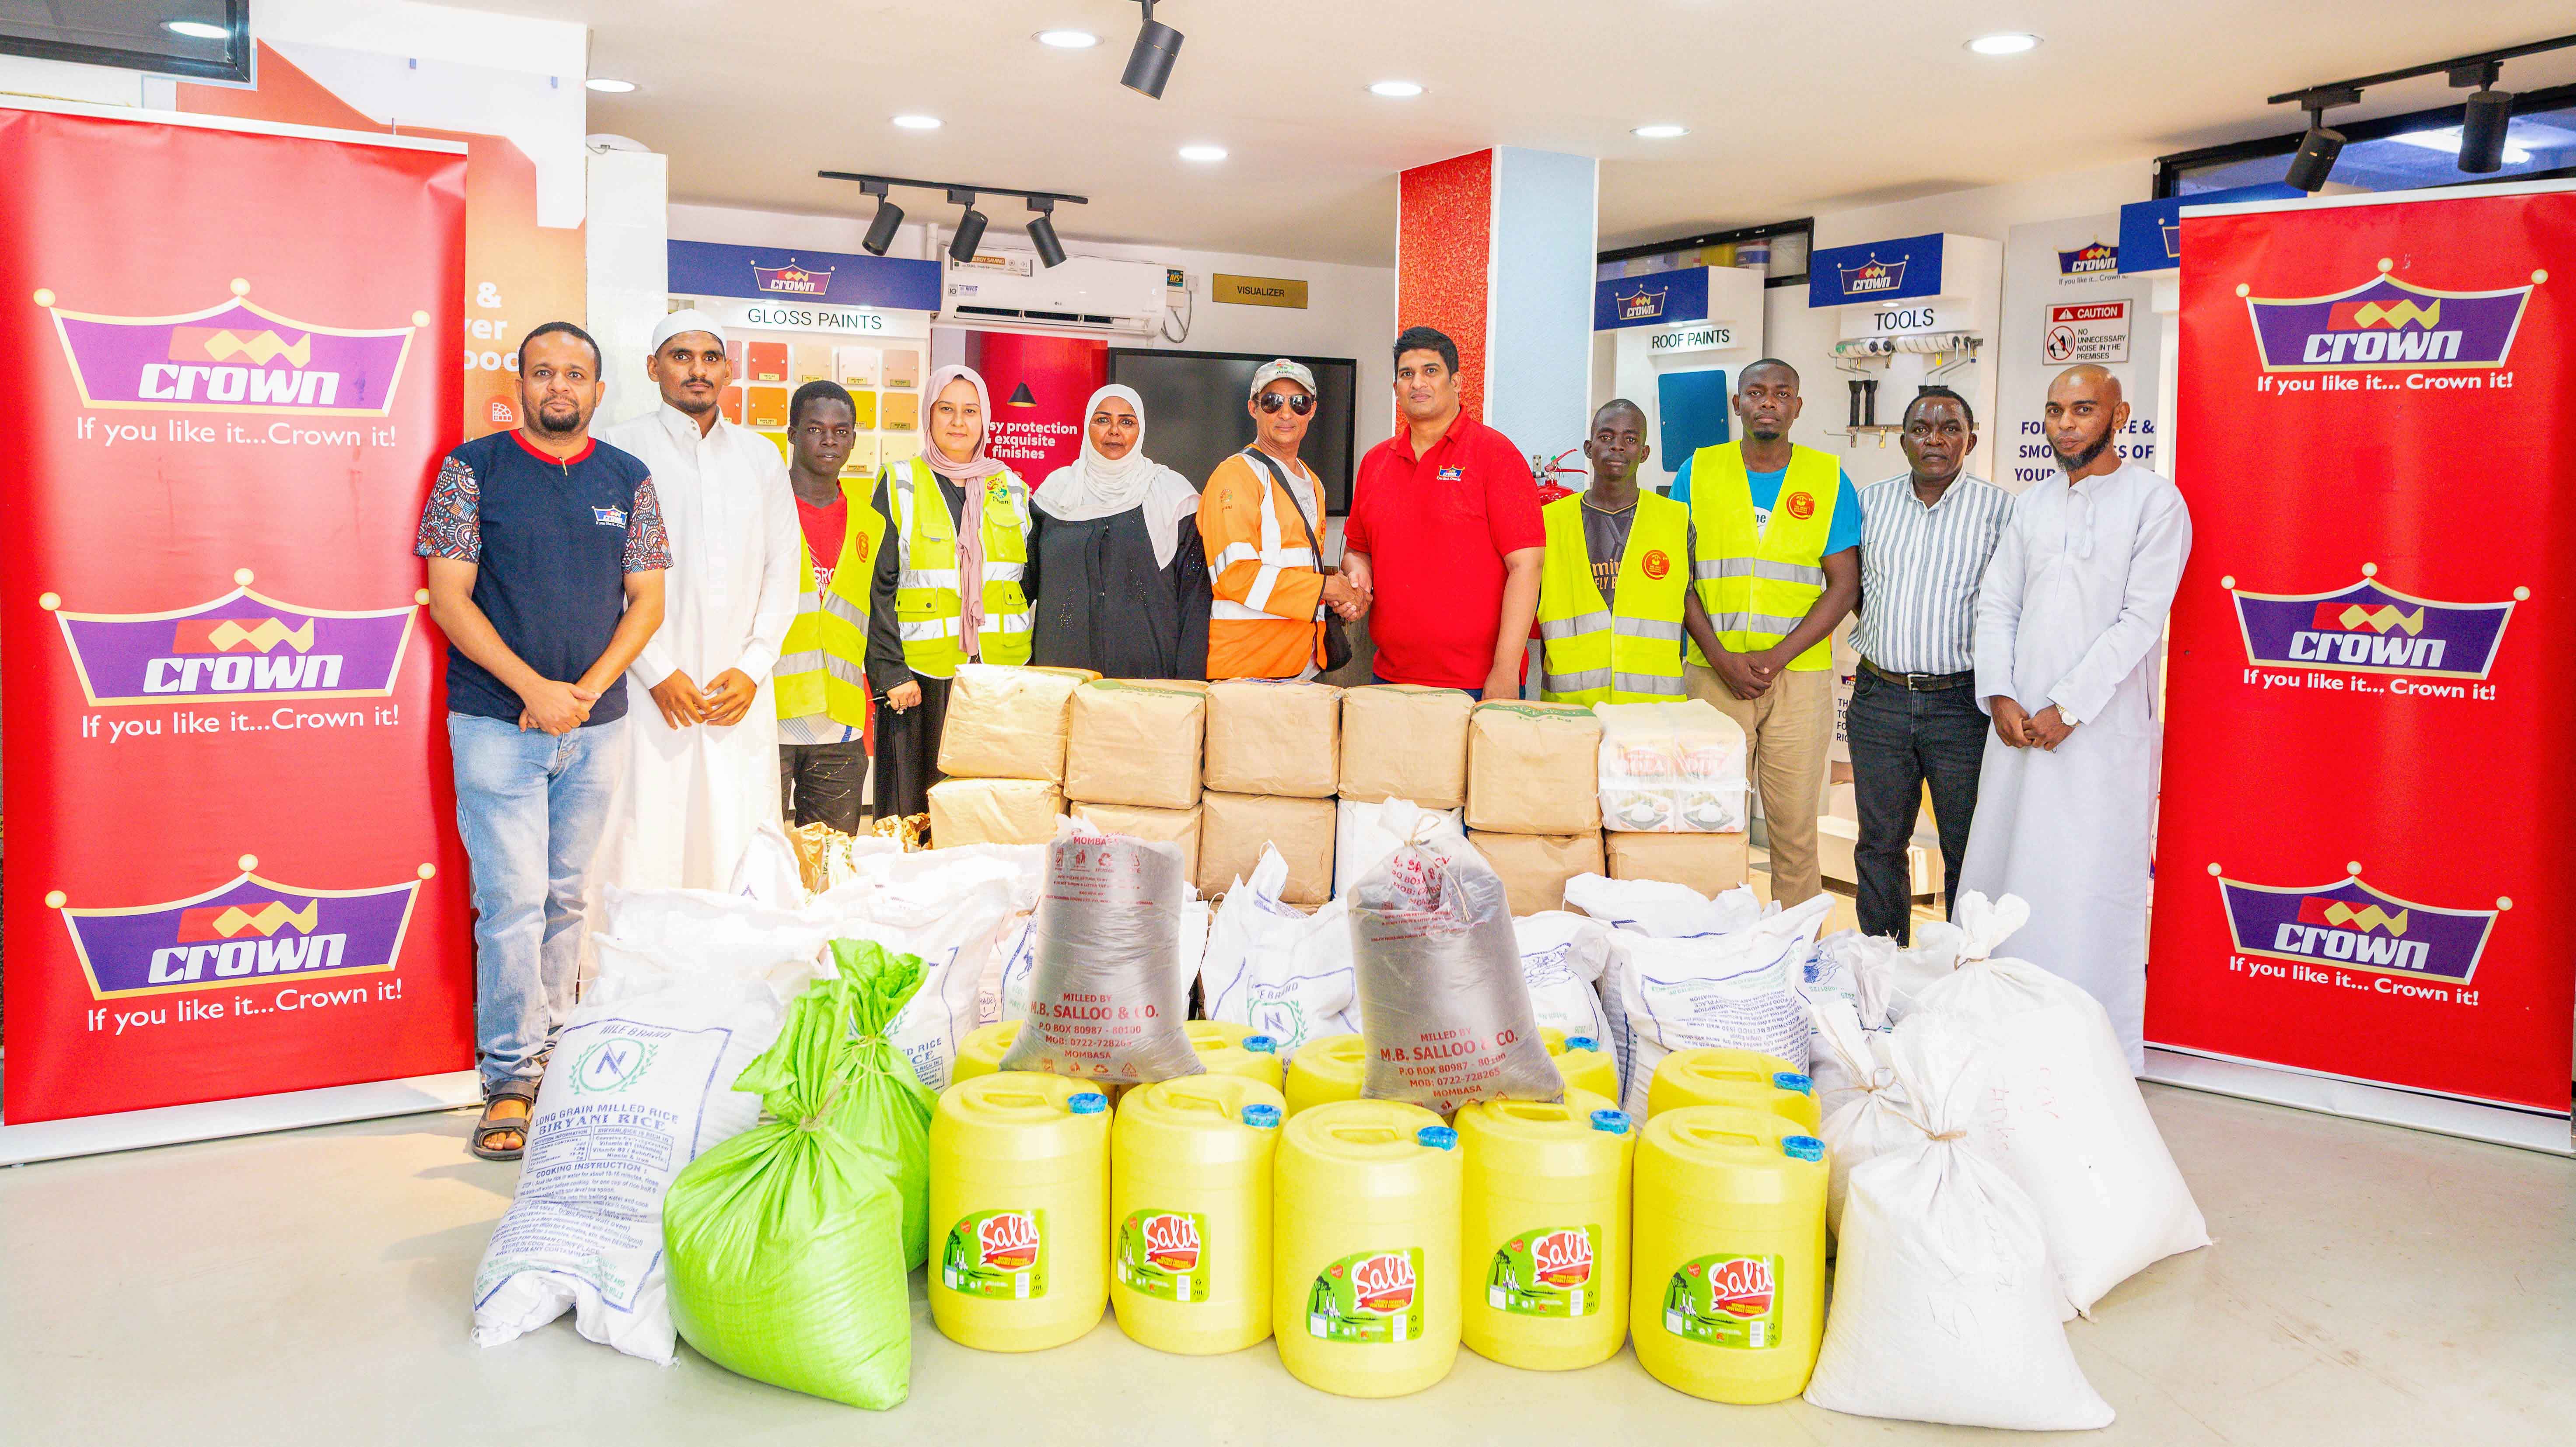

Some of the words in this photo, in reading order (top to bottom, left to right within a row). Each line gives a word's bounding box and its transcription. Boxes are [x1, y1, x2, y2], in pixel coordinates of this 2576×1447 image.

[477, 281, 502, 308] &
[1237, 285, 1285, 298] VISUALIZER
[748, 308, 812, 326] GLOSS
[818, 312, 882, 329] PAINTS
[1874, 308, 1934, 331] TOOLS
[2078, 307, 2118, 319] CAUTION
[1651, 333, 1684, 349] ROOF
[1687, 329, 1730, 345] PAINTS
[2078, 335, 2126, 343] UNNECESSARY
[2258, 376, 2271, 391] If
[2277, 379, 2314, 395] you
[2322, 375, 2359, 390] like
[2406, 373, 2482, 389] Crown
[2489, 372, 2513, 388] it!
[77, 417, 94, 439] If
[105, 423, 156, 447] you
[169, 420, 215, 442] like
[371, 425, 396, 447] it!
[1007, 422, 1077, 434] protection
[2021, 422, 2045, 434] FO
[2142, 420, 2154, 434] &
[995, 434, 1056, 448] exquisite
[992, 445, 1045, 459] finishes
[2132, 445, 2154, 459] OF
[993, 496, 1010, 505] Pwani
[2244, 669, 2259, 685] If
[2263, 674, 2300, 689] you
[2307, 673, 2344, 690] like
[2390, 680, 2465, 699] Crown
[2472, 684, 2496, 701] it!
[82, 715, 101, 738] If
[109, 717, 161, 743] you
[173, 711, 220, 733] like
[374, 704, 399, 726] it!
[2230, 956, 2244, 972] If
[2249, 962, 2285, 978] you
[2293, 965, 2329, 984] like
[2374, 978, 2448, 1002] Crown
[2456, 989, 2479, 1006] it!
[1063, 993, 1097, 1002] MILLED
[1101, 994, 1112, 1002] BY
[88, 1008, 105, 1032] If
[115, 1009, 166, 1035] you
[178, 1000, 224, 1022] like
[377, 978, 402, 1000] it!
[1031, 1002, 1050, 1017] M.B.
[1053, 1005, 1113, 1020] SALLOO
[1118, 1006, 1129, 1020] &
[1054, 1024, 1072, 1034] BOX
[1074, 1026, 1103, 1034] 80987
[1767, 1016, 1800, 1032] MICROWAVE
[627, 1026, 672, 1039] BRAND
[1045, 1035, 1068, 1046] MOB:
[1420, 1030, 1457, 1042] MILLED
[1459, 1027, 1472, 1037] BY
[918, 1037, 941, 1053] RICE
[1381, 1046, 1409, 1062] M.B.
[1412, 1040, 1476, 1061] SALLOO
[1496, 1029, 1519, 1046] CO.
[1064, 1050, 1111, 1059] MOMBASA
[1399, 1066, 1415, 1075] P.O
[1416, 1064, 1437, 1075] BOX
[1438, 1061, 1468, 1074] 80987
[1410, 1076, 1434, 1089] MOB:
[1433, 1084, 1482, 1097] MOMBASA
[535, 1113, 556, 1127] LONG
[559, 1105, 593, 1118] GRAIN
[598, 1104, 645, 1113] MILLED
[649, 1108, 679, 1125] RICE
[539, 1114, 609, 1135] BIRYANI
[619, 1114, 666, 1132] RICE
[536, 1164, 571, 1178] COOKING
[574, 1162, 641, 1172] INSTRUCTION
[977, 1211, 1039, 1254] Salit
[1143, 1213, 1200, 1253] Salit
[1531, 1227, 1594, 1273] Salit
[1351, 1250, 1416, 1296] Salit
[1708, 1257, 1774, 1299] Salit
